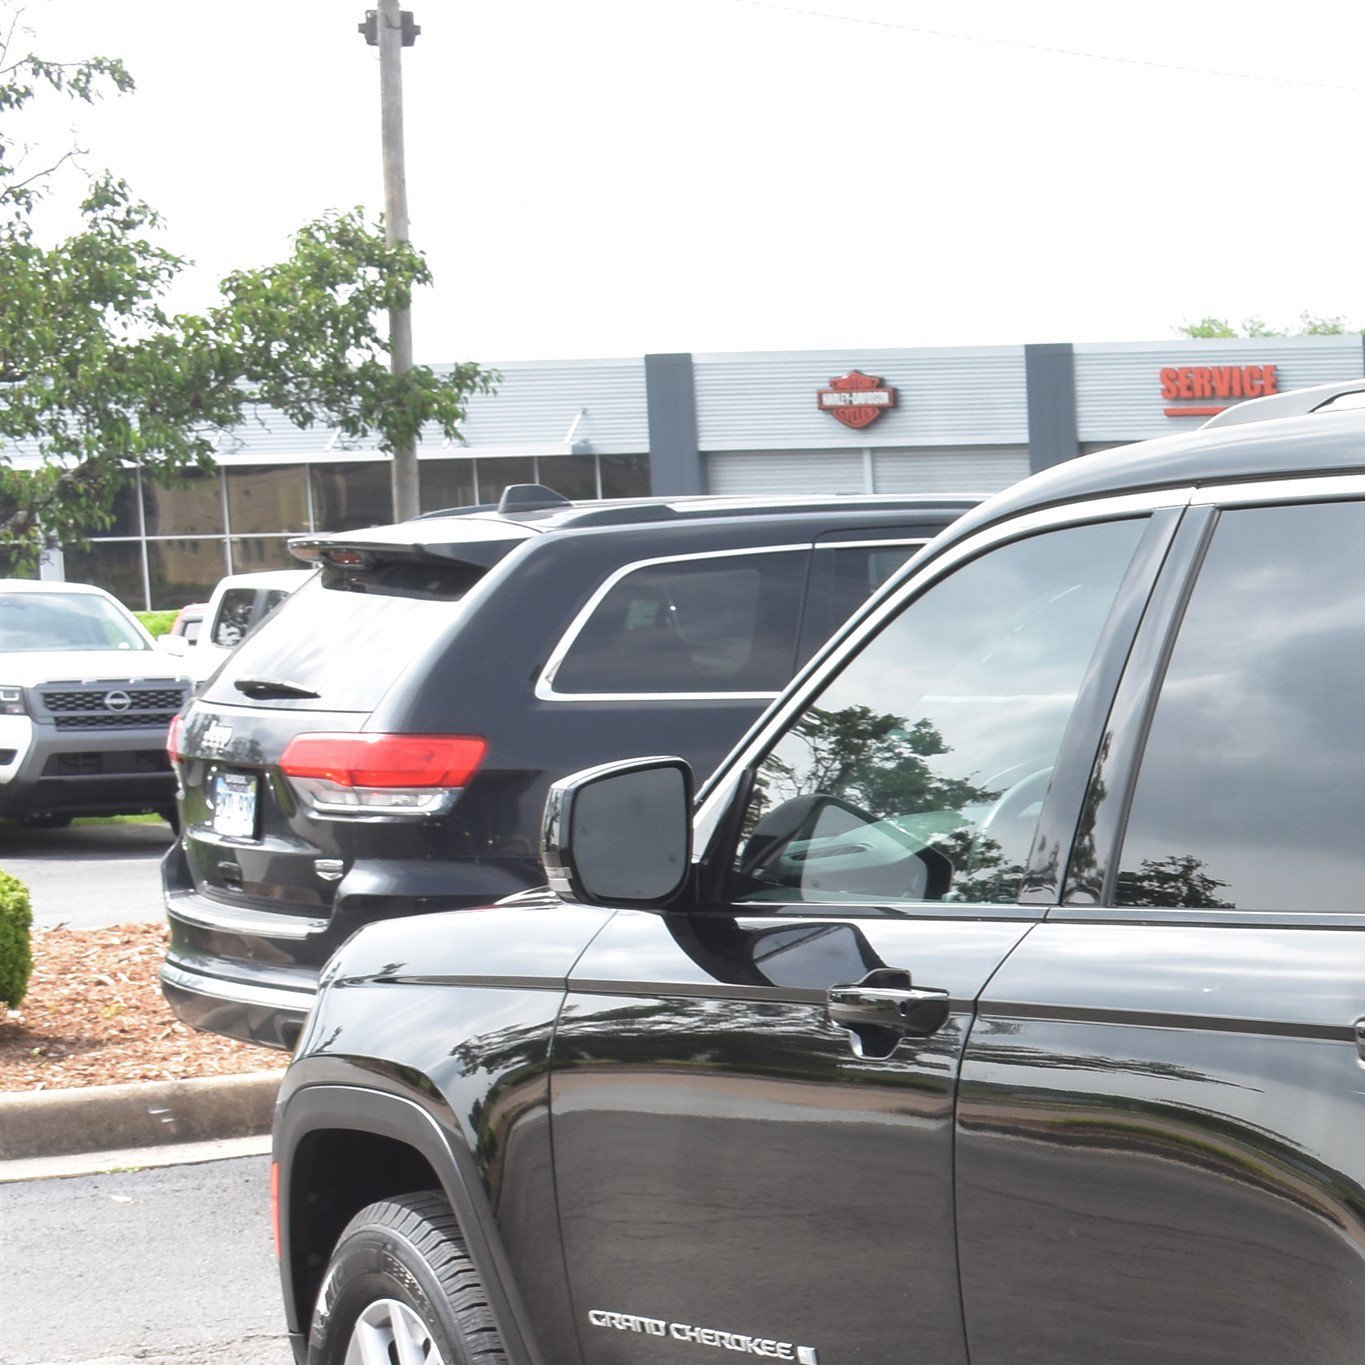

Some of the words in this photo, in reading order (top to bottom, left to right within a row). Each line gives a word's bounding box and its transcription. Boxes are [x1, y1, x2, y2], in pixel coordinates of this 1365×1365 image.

[1160, 364, 1278, 400] SERVICE
[588, 1309, 667, 1337] GRAND
[670, 1322, 795, 1361] CHEROKEE
